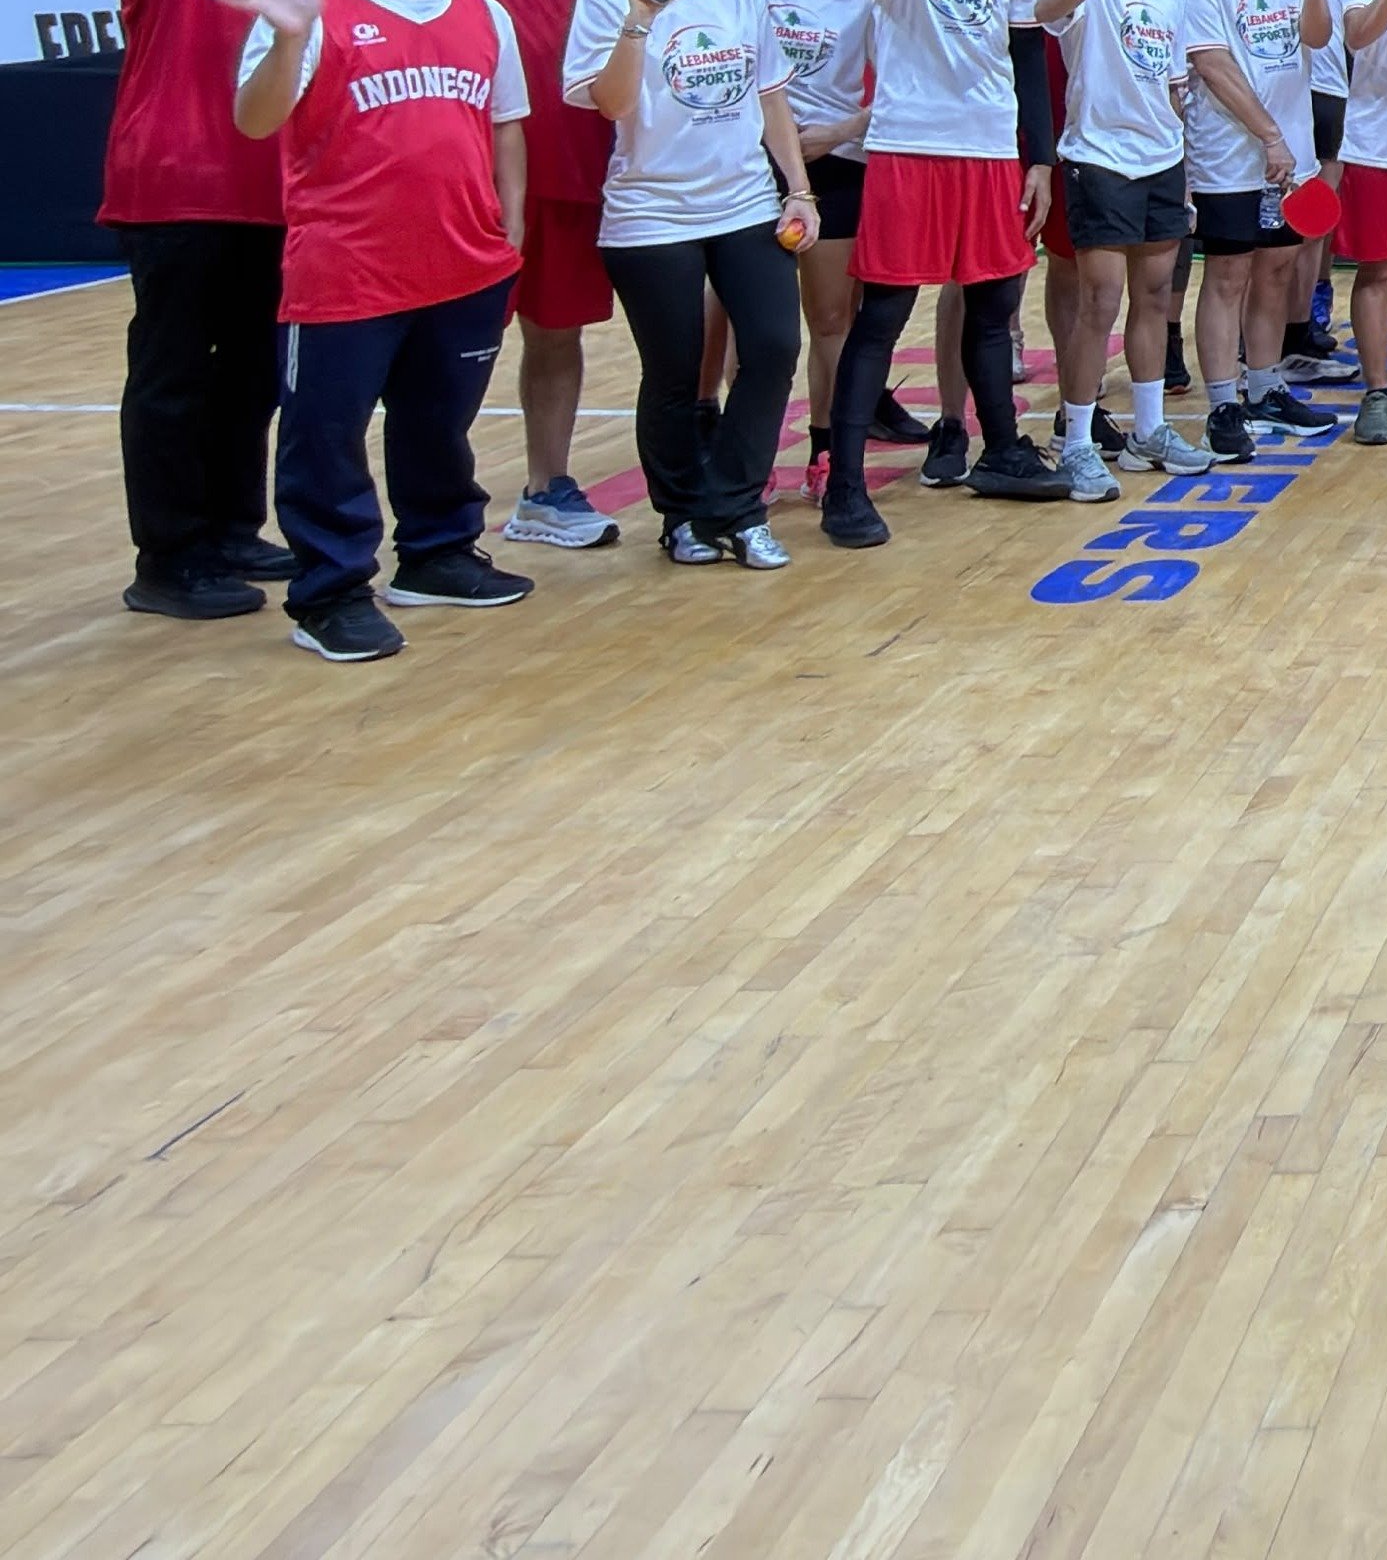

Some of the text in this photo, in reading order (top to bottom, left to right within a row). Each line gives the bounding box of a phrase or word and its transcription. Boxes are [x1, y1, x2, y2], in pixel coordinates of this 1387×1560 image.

[34, 8, 126, 60] EDE
[774, 26, 821, 42] BANESE
[679, 47, 743, 68] LEBANESE
[782, 46, 815, 61] RTS
[685, 69, 743, 89] SPORTS
[350, 66, 491, 113] INDONESIA
